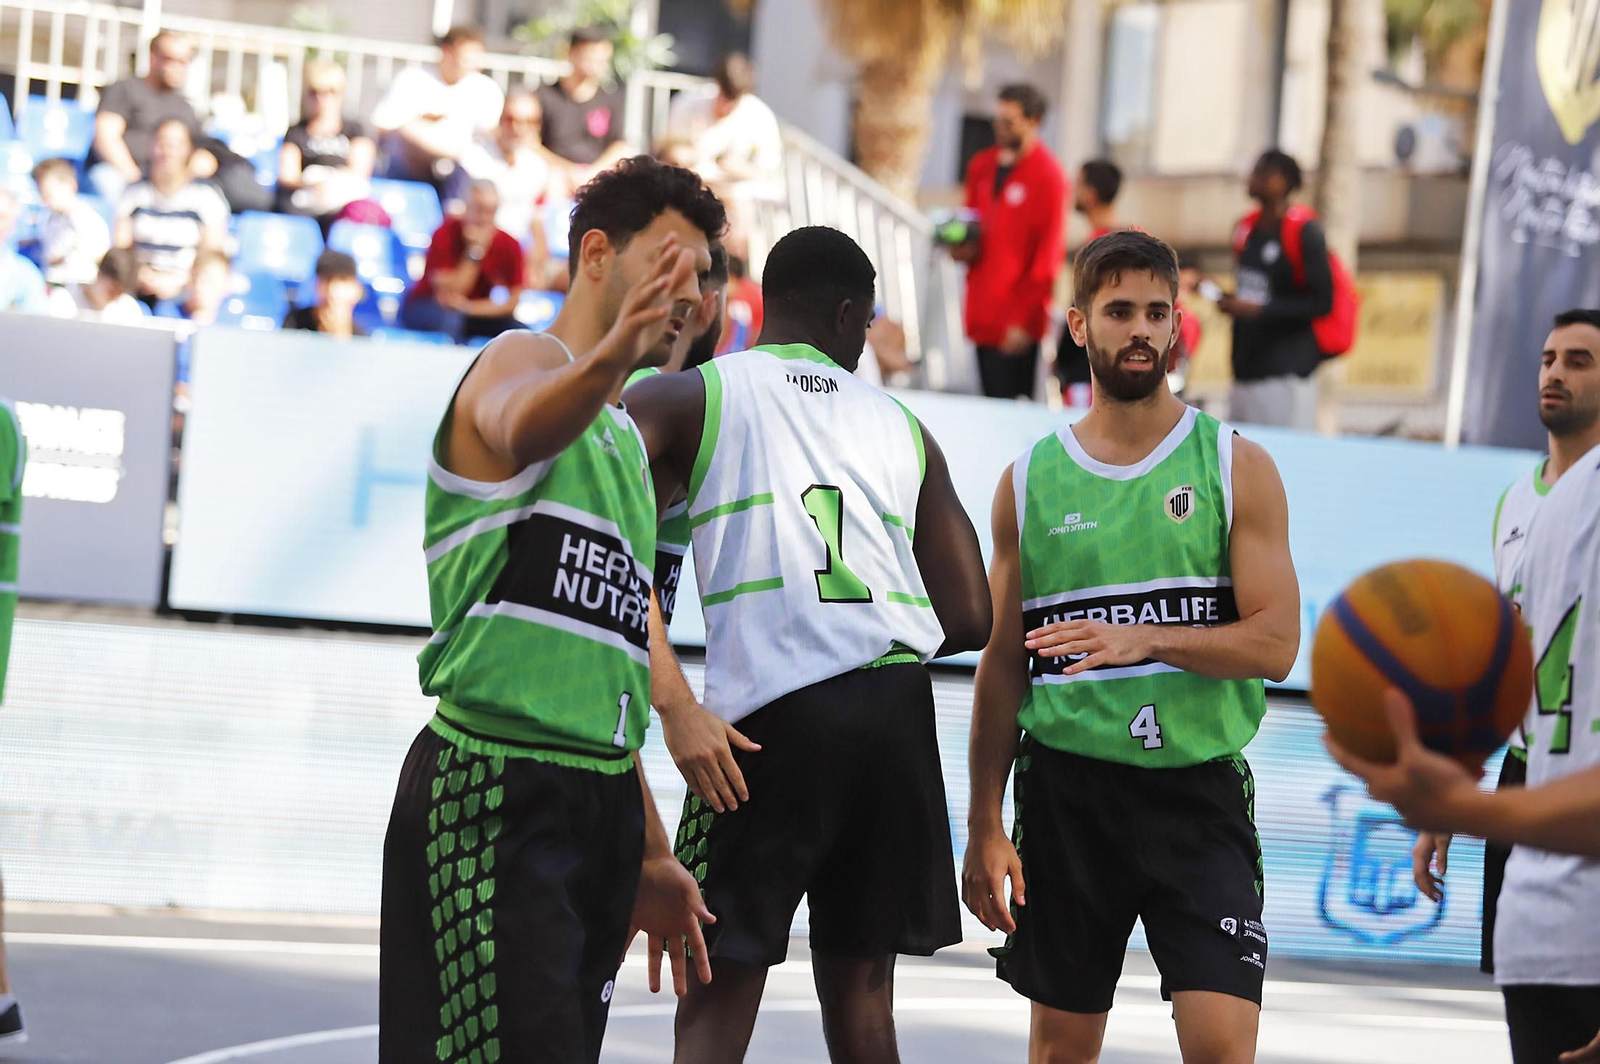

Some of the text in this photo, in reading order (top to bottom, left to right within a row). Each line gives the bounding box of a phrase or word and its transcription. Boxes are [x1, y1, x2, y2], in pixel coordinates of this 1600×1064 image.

[1169, 492, 1189, 518] 100
[800, 484, 874, 603] 1
[612, 690, 632, 749] 1
[1128, 703, 1164, 751] 4
